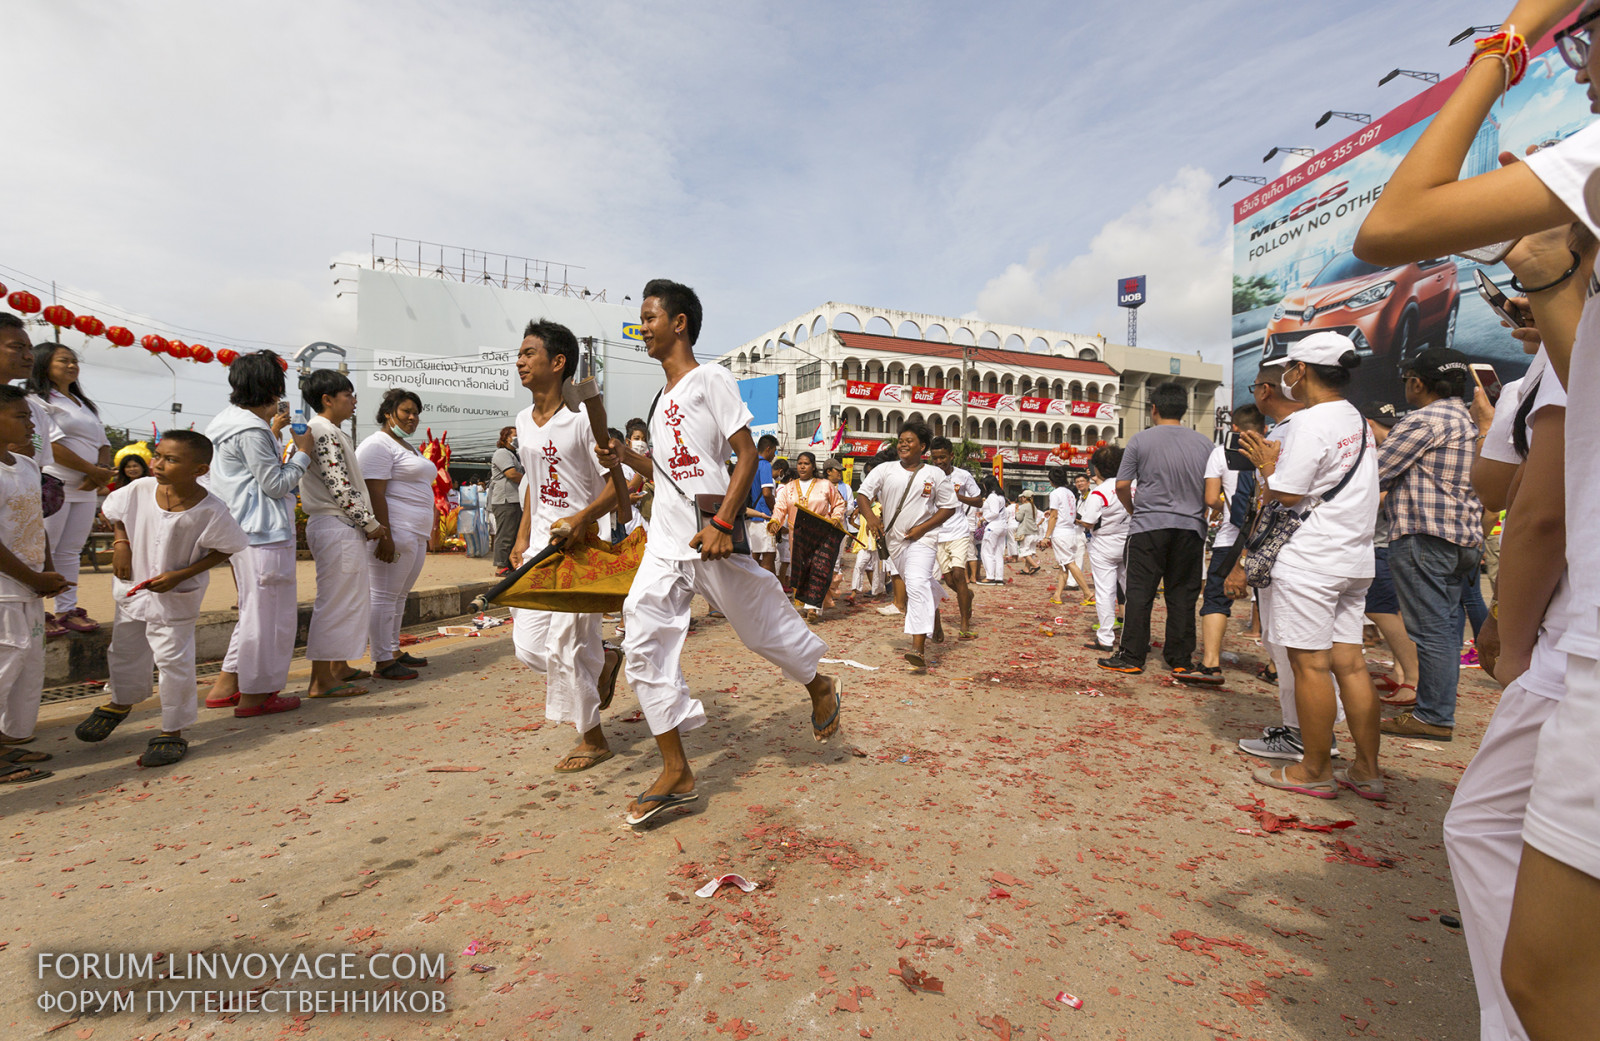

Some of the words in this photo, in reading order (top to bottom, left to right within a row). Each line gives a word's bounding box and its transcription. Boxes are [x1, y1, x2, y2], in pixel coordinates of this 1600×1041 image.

[1261, 183, 1284, 205] ภูเก็ต
[1286, 173, 1305, 188] โทร.
[1307, 124, 1382, 176] 076-355-097
[1249, 224, 1304, 262] FOLLOW
[1307, 212, 1331, 232] NO
[1336, 182, 1388, 217] OTHE
[1121, 293, 1142, 303] UOB
[378, 356, 510, 377] เรามีไอเดียแต่งบ้านมากมาย
[481, 351, 510, 362] สวัสดี
[373, 372, 510, 391] รอคุณอยู่ในแคตตาล็อกเล่มนี้
